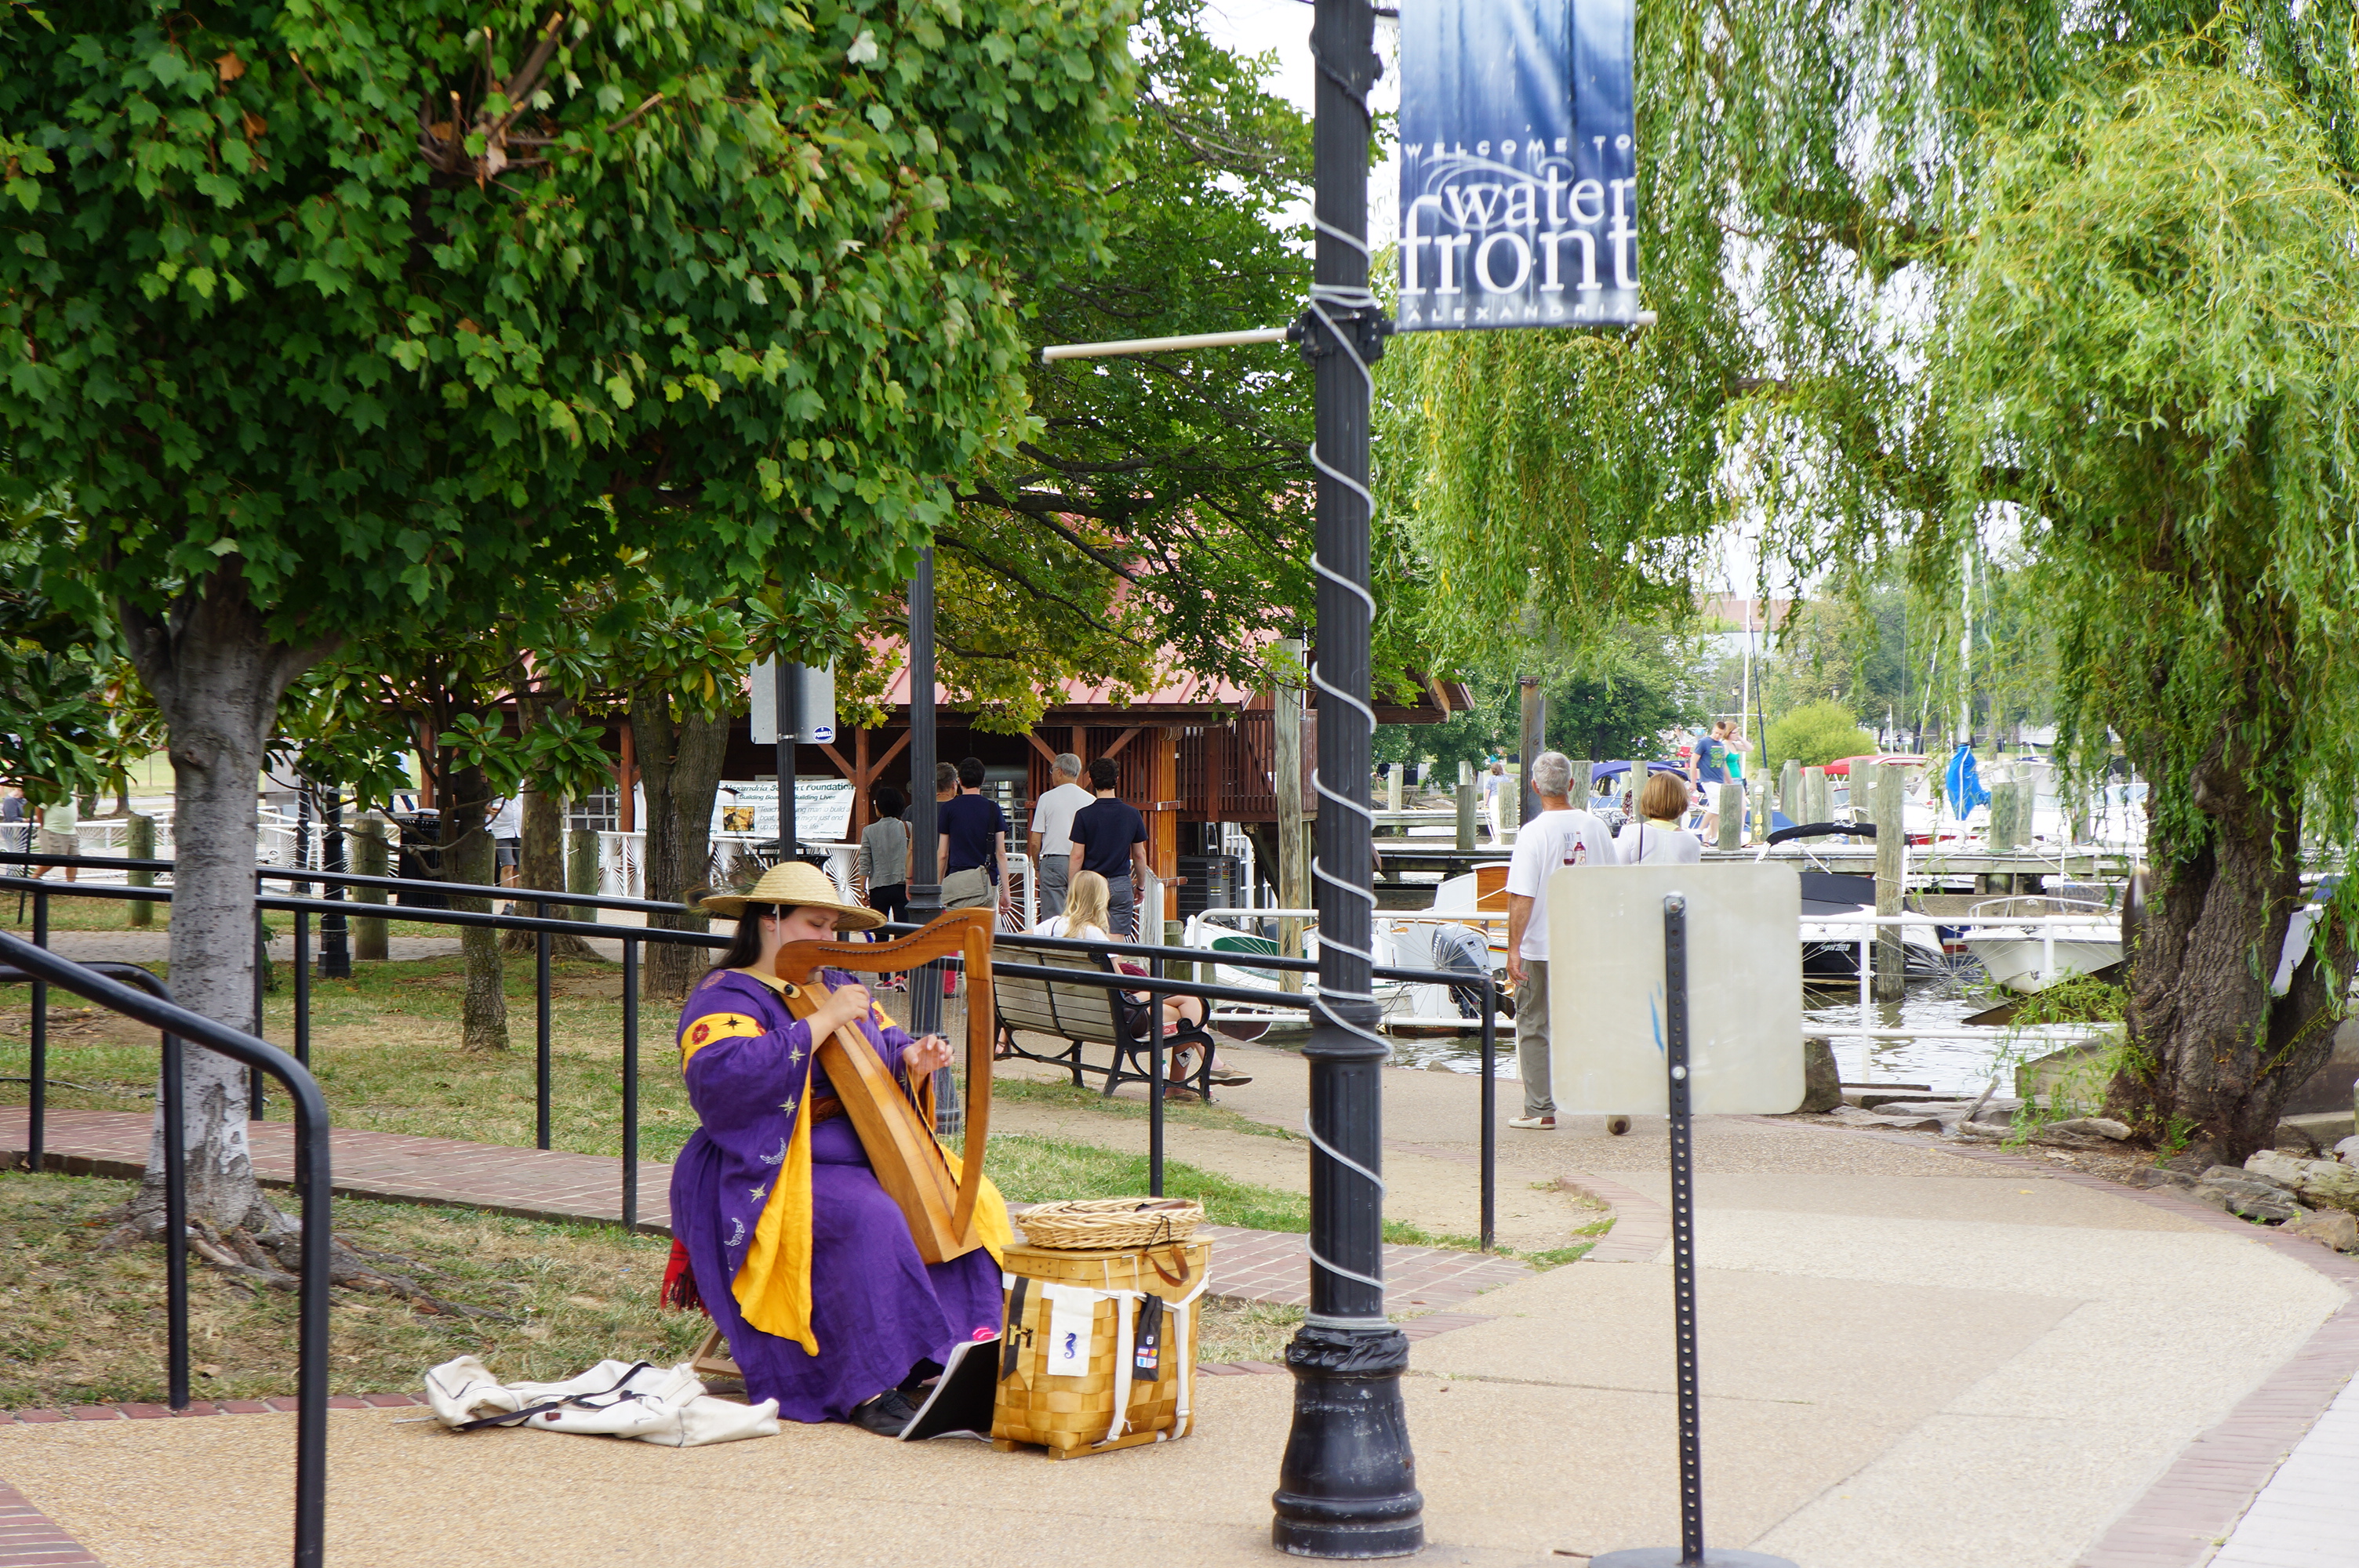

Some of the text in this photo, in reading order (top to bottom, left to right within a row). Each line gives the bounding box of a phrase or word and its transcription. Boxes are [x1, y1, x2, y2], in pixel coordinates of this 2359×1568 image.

[1405, 133, 1632, 158] WELCOME TO
[1445, 165, 1636, 228] water
[1398, 194, 1639, 296] front
[1408, 303, 1629, 323] ALEXANDRIA
